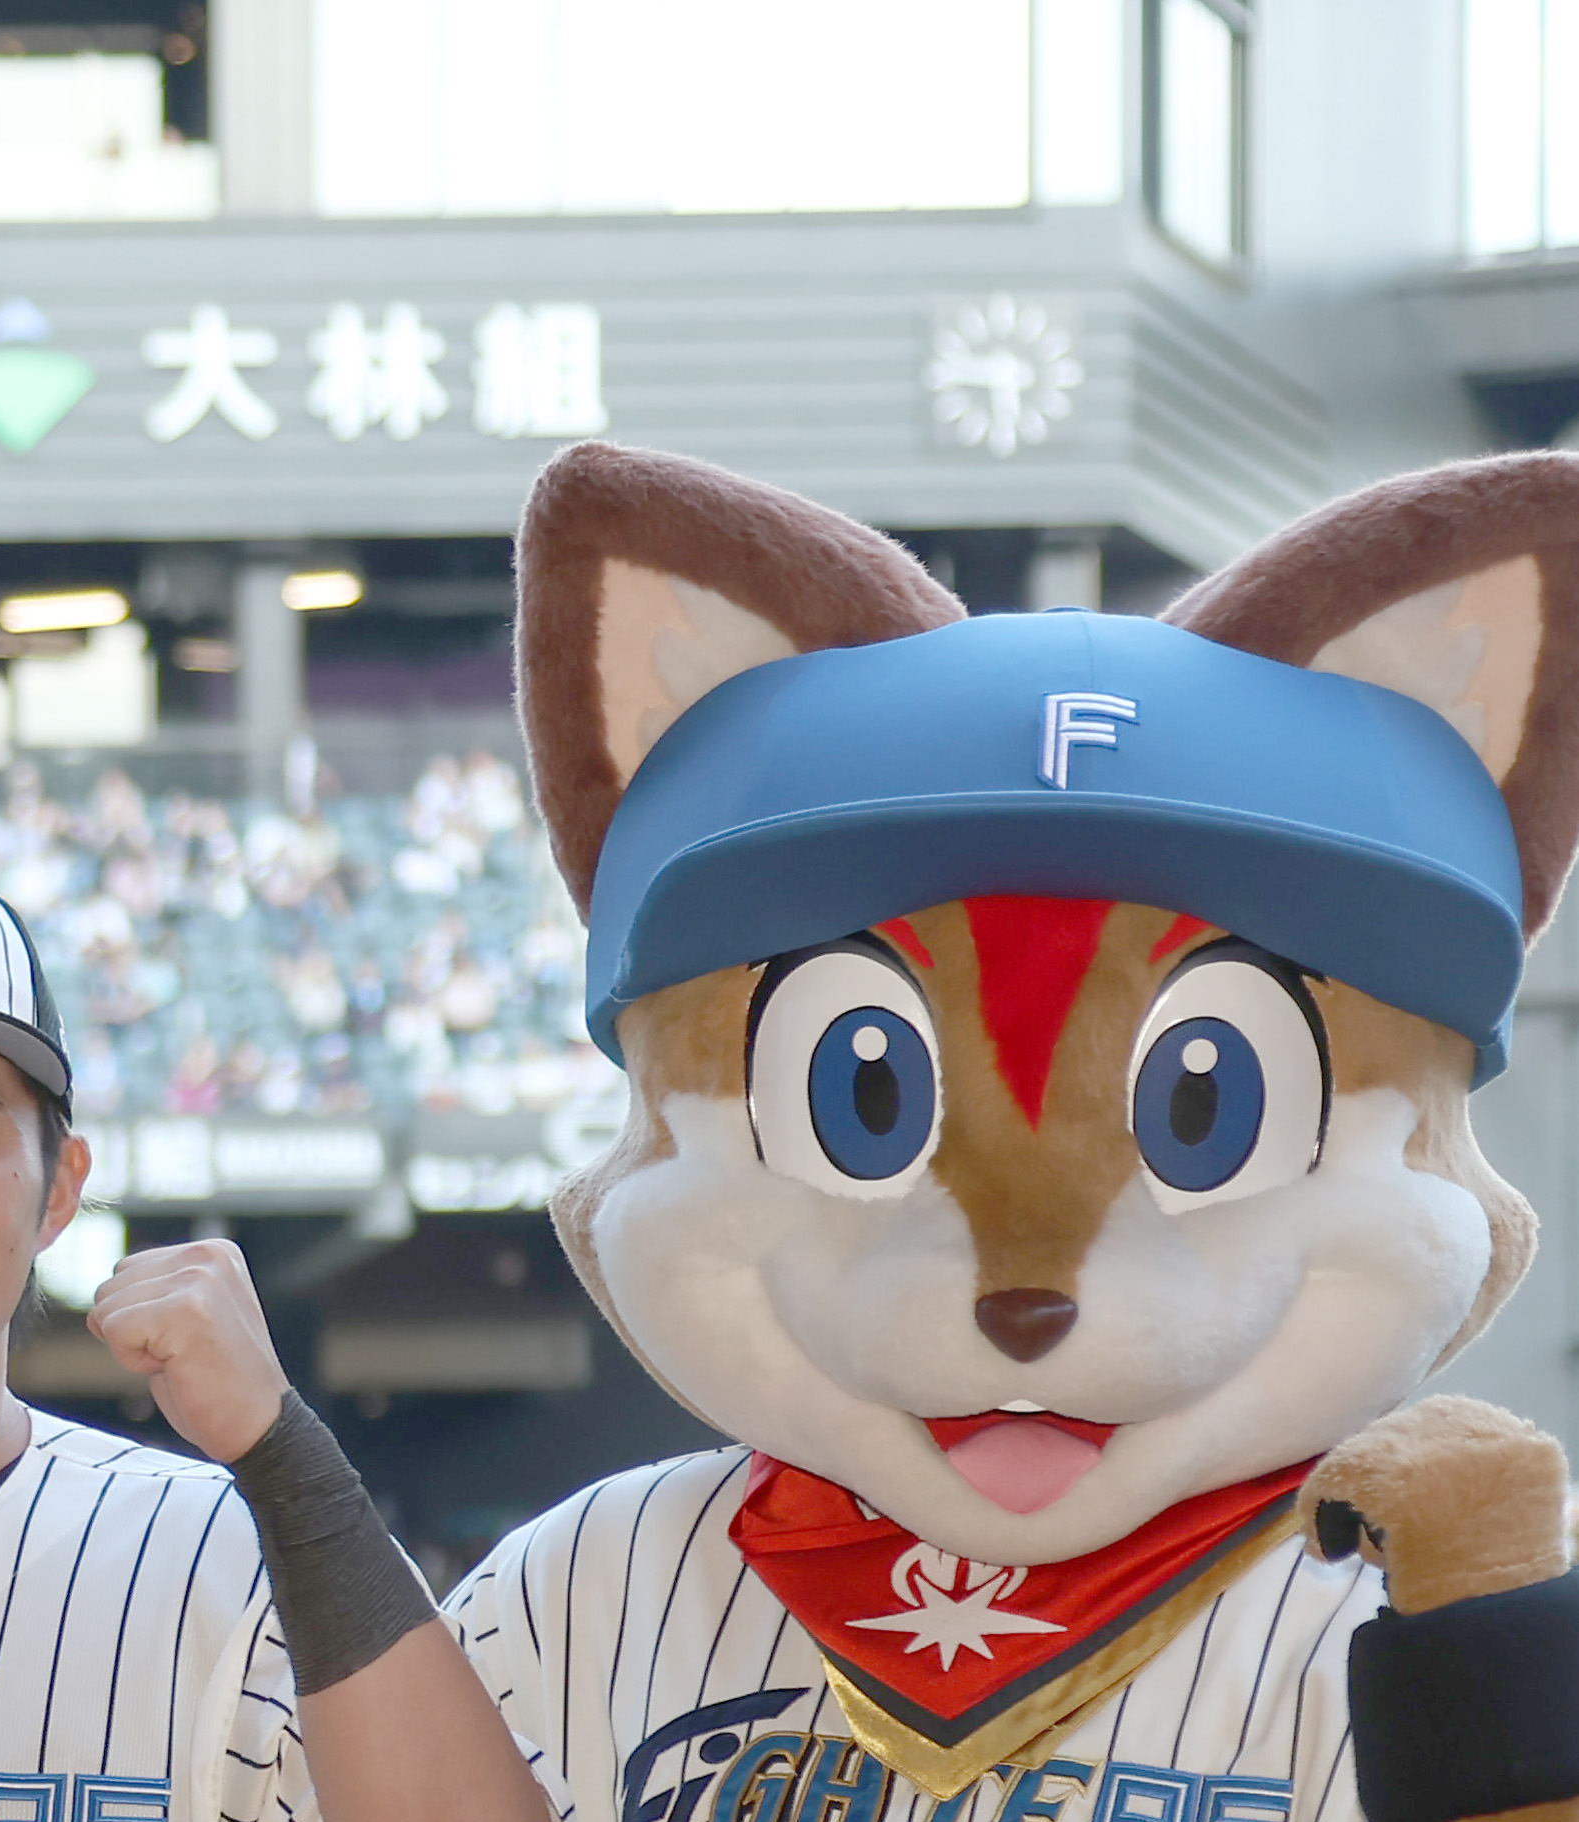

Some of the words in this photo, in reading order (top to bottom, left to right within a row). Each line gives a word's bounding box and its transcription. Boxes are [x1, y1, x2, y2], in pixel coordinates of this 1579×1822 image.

[141, 302, 609, 442] 大林組
[1038, 691, 1139, 790] F
